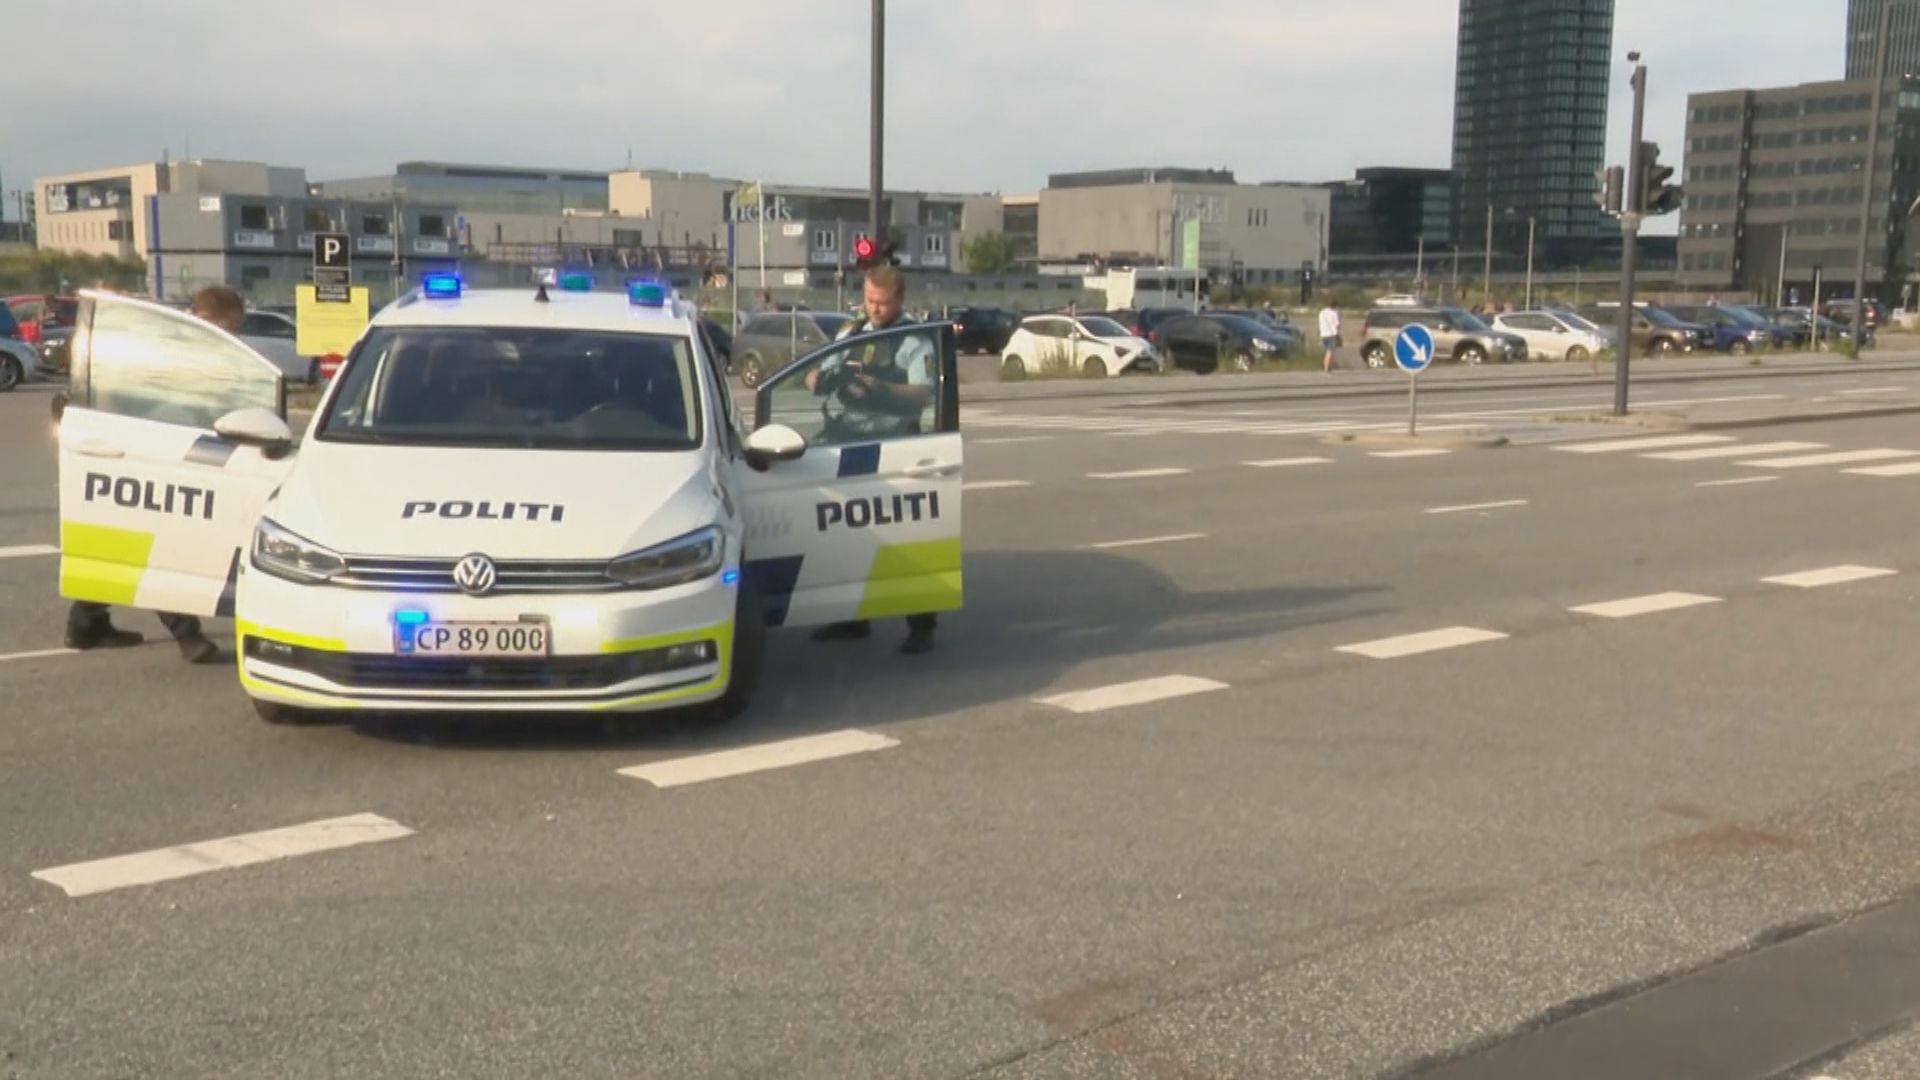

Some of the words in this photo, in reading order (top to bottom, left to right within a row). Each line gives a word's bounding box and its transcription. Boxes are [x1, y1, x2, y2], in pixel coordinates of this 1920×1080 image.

[324, 237, 341, 263] P
[85, 472, 214, 520] POLITI
[402, 501, 564, 522] POLITI
[816, 490, 940, 531] POLITI
[417, 628, 450, 651] CP
[458, 628, 489, 651] 89
[496, 628, 543, 651] 000
